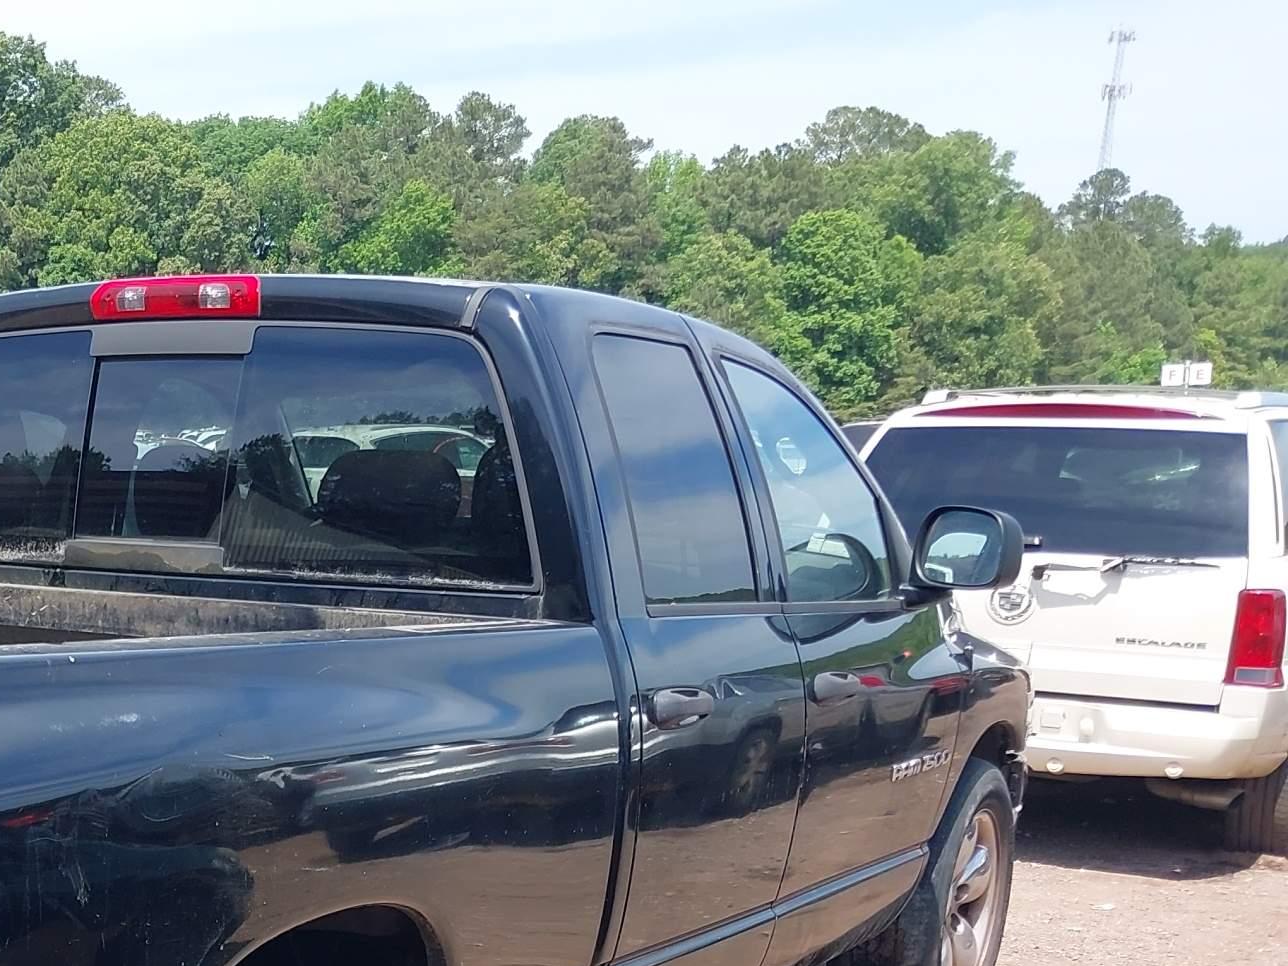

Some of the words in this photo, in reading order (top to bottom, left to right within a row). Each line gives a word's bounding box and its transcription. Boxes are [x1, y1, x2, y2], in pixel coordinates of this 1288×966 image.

[1169, 369, 1177, 381] F
[1196, 369, 1205, 380] E
[1115, 637, 1208, 650] ESCALADE
[892, 758, 921, 782] RAM
